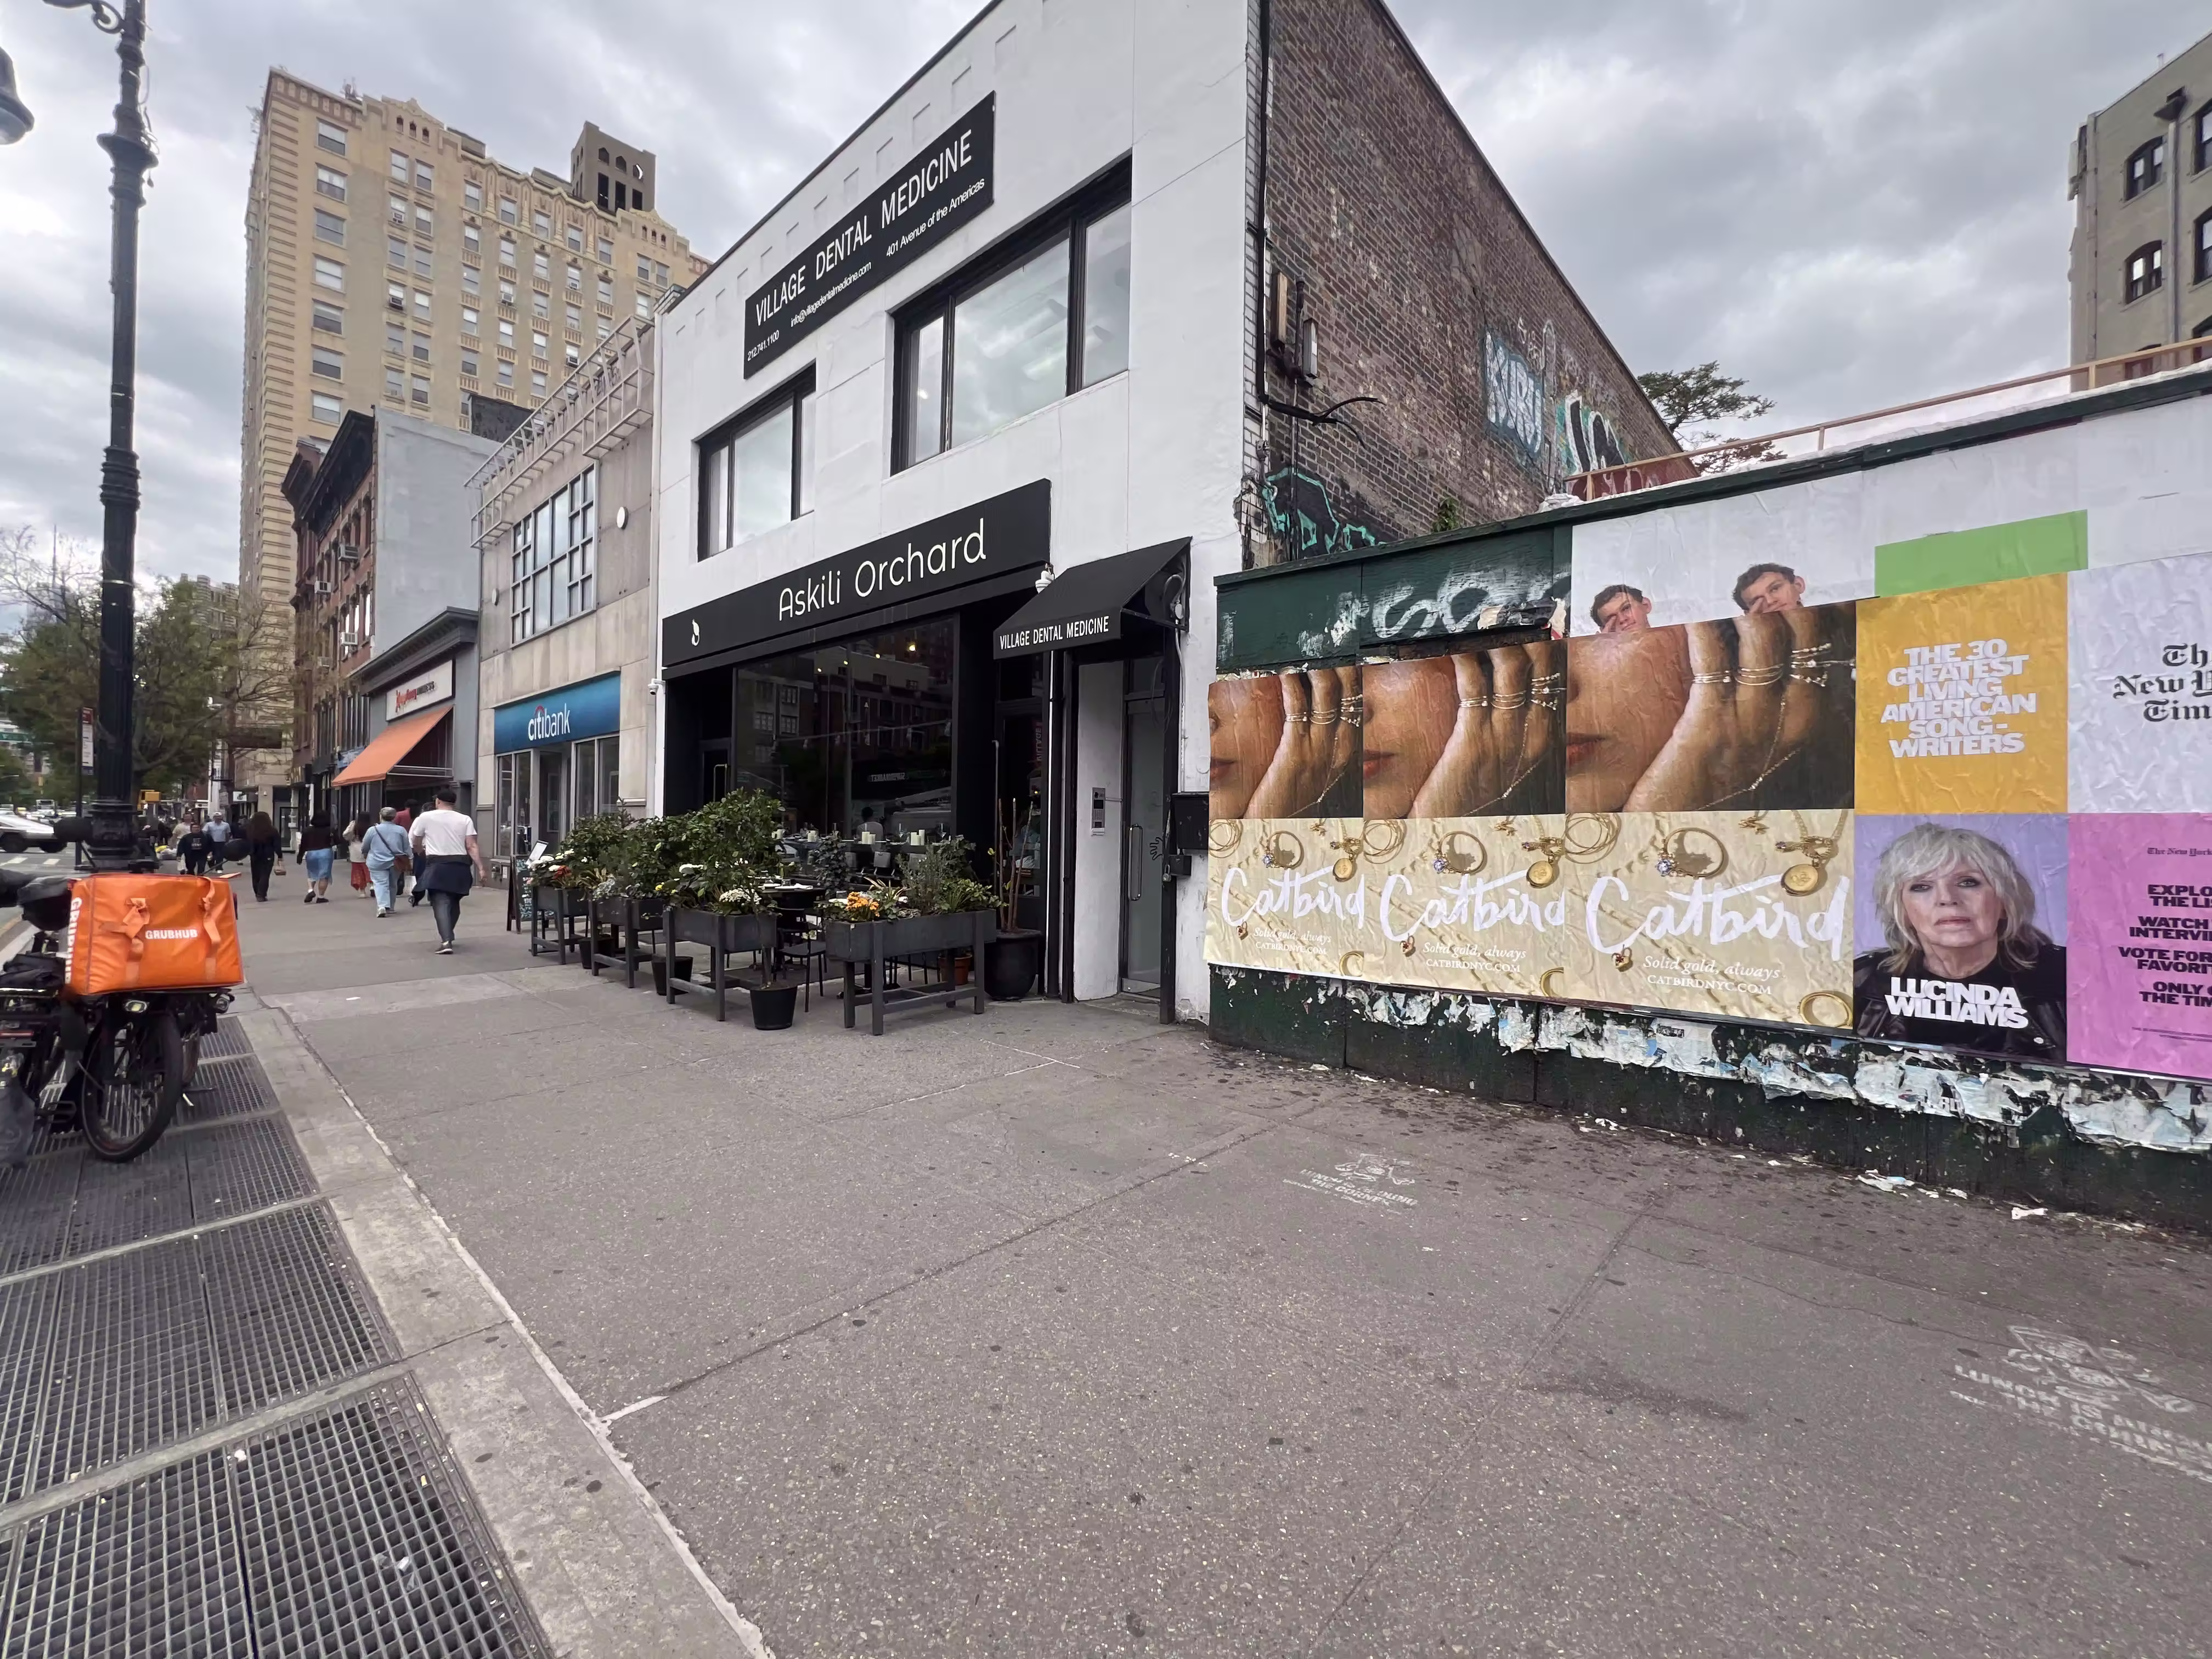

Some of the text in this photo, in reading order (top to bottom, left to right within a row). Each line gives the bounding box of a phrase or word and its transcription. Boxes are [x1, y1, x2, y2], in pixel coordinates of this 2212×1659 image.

[756, 129, 971, 326] VILLAGE DENTAL MEDICINE
[887, 178, 985, 257] 401 Avenue of the Americas
[791, 262, 872, 327] info@villagedentalmedicine.com
[748, 330, 780, 361] 212.741.1100
[779, 518, 986, 621] Askili Orchard
[1000, 616, 1109, 650] VILLAGE DENTAL MEDICINE
[1904, 639, 2007, 666] THE 30
[2162, 642, 2212, 668] Th
[1887, 654, 2029, 686] GREATEST
[1909, 678, 2002, 702] LIVING
[2113, 674, 2186, 699] New
[1880, 693, 2036, 723] AMERICAN
[528, 703, 570, 741] citibank
[1908, 716, 2008, 738] SONG-
[1889, 732, 2025, 758] WRITERS
[1221, 865, 1364, 929] Catbird
[2149, 896, 2189, 907] THE
[1585, 872, 1850, 961] Catbird
[2138, 916, 2209, 929] WATCH
[145, 929, 198, 940] GRUBHUB
[1253, 927, 1276, 938] Solid
[1301, 930, 1332, 945] always
[1255, 941, 1327, 955] CATBIRDNYC.COM
[1423, 942, 1527, 961] Solid gold, always
[2118, 946, 2212, 962] VOTE FOR
[1426, 959, 1521, 972] CATBIRDNYC.COM
[1643, 956, 1781, 981] Solid gold, always
[1647, 975, 1772, 995] CATBIRDNYC.COM
[1891, 977, 2022, 1008] LUCINDA
[2153, 981, 2204, 995] ONLY
[2139, 991, 2180, 1005] THE
[1884, 995, 2029, 1029] WILLIAMS
[2069, 1400, 2103, 1420] IS
